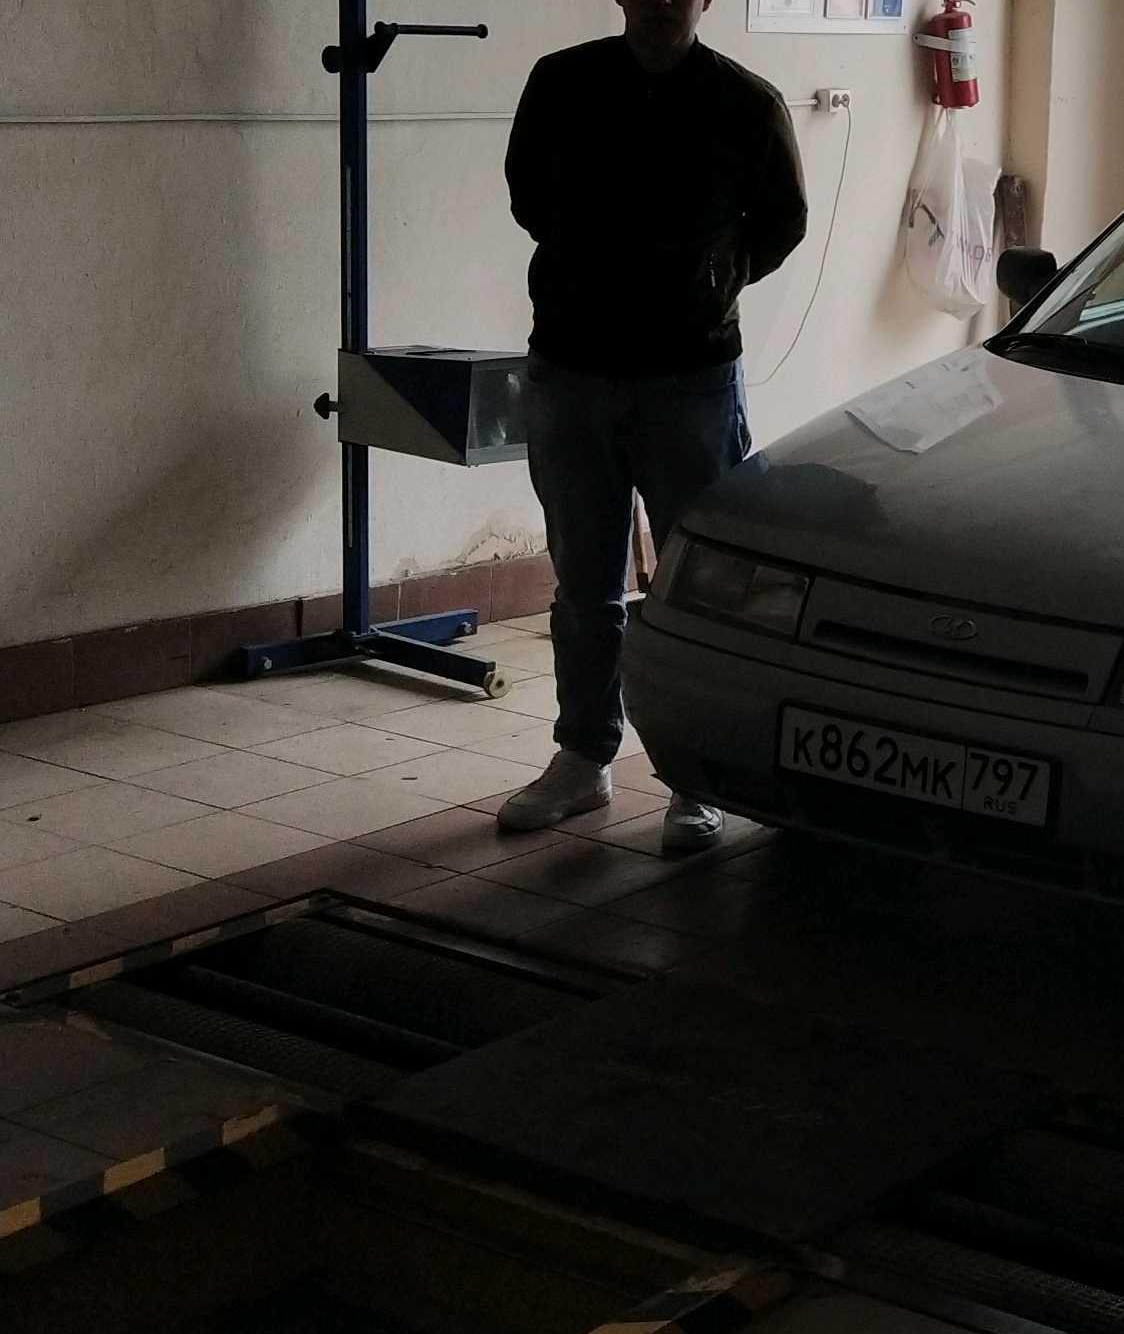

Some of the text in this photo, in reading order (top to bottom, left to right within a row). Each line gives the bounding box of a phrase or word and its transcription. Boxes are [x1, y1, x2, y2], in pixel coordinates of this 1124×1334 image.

[792, 723, 1039, 801] К862МК 797
[983, 796, 1017, 816] RUS
